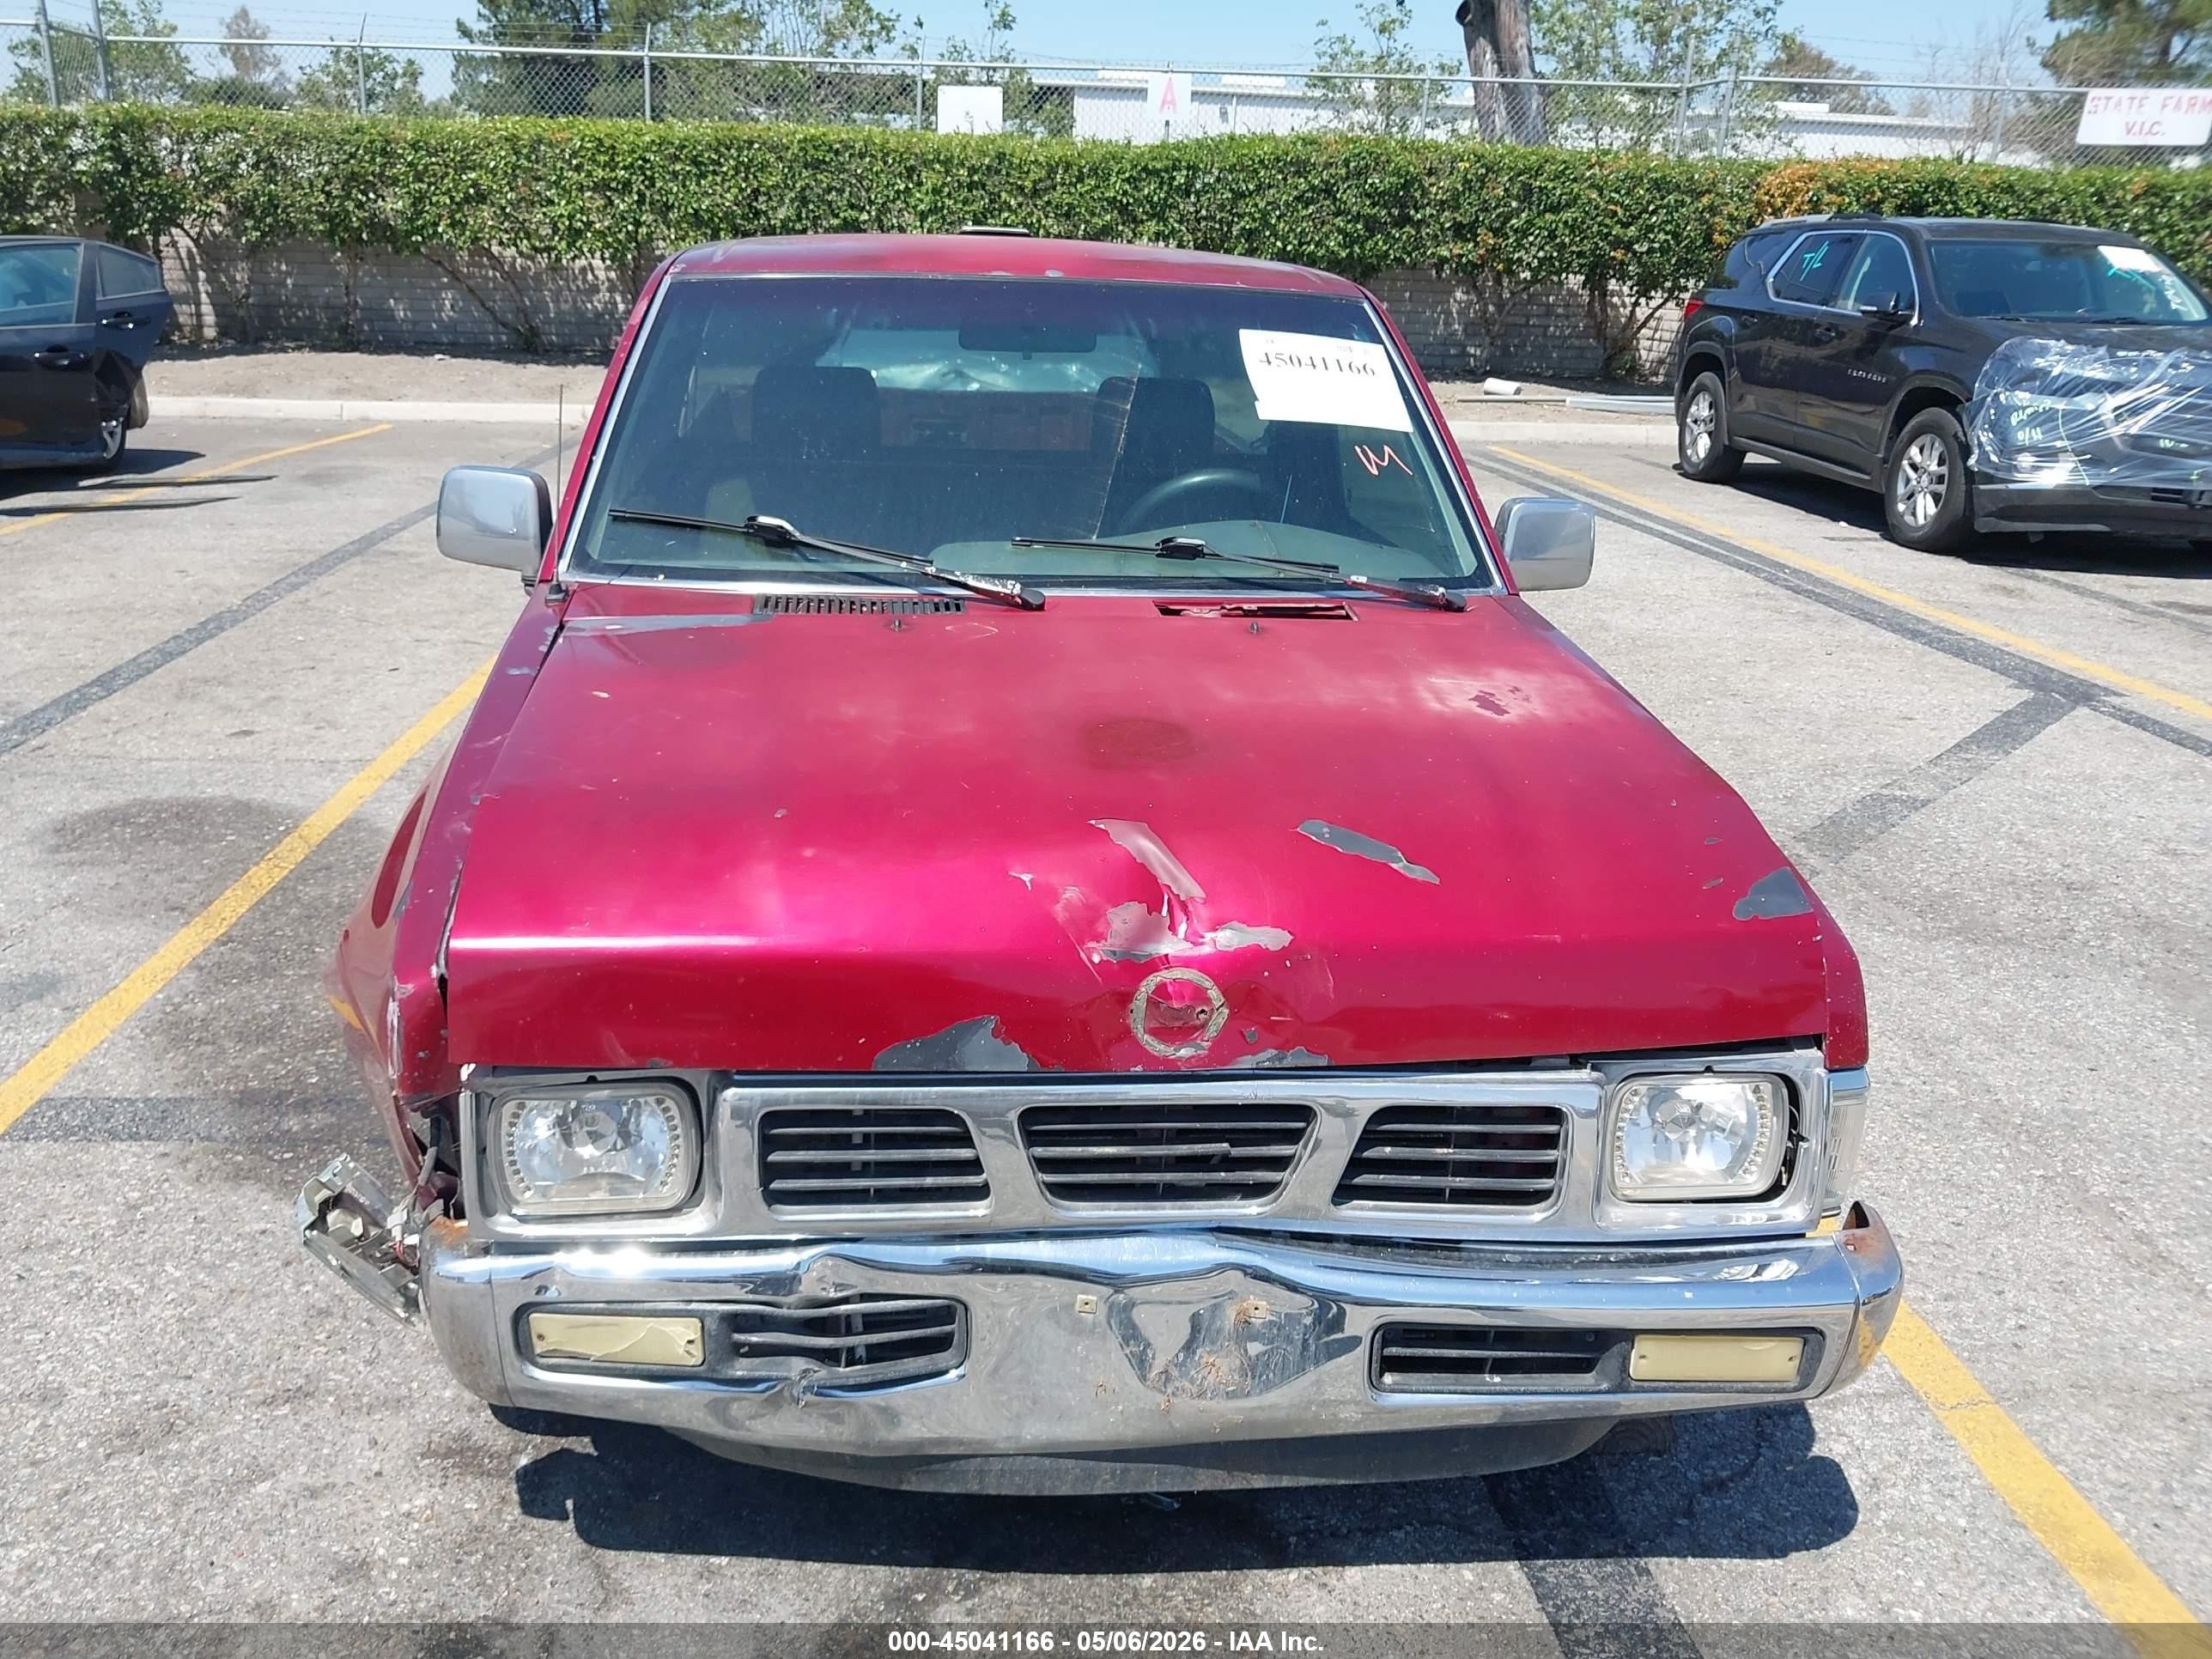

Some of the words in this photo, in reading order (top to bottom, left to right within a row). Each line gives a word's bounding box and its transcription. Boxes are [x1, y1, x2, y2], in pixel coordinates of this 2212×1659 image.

[1159, 76, 1178, 112] A
[2087, 95, 2150, 114] STATE
[1259, 351, 1376, 377] 45041166
